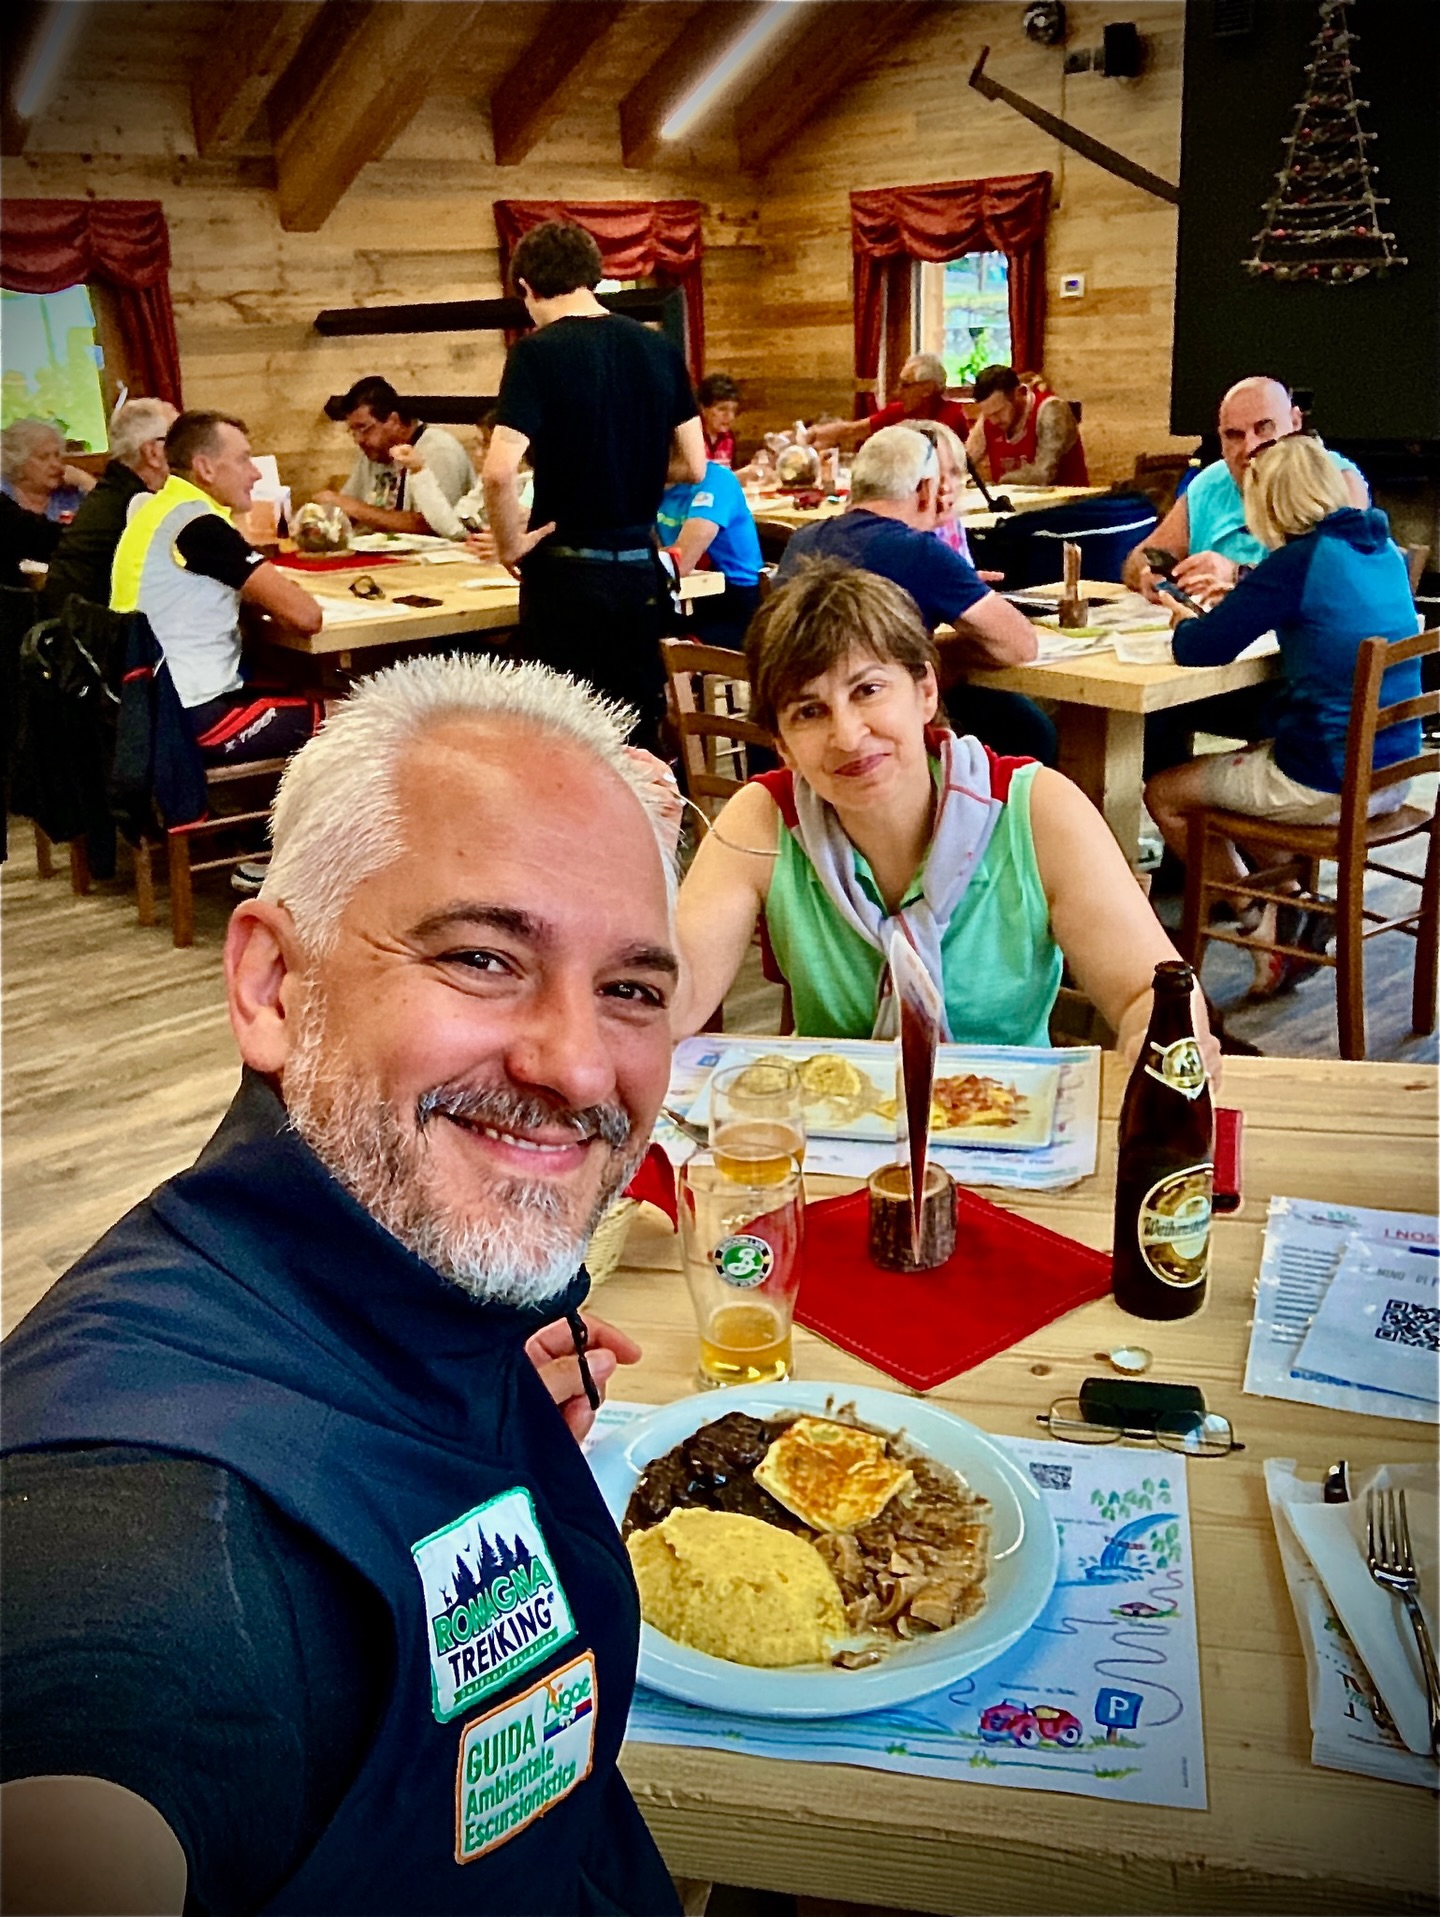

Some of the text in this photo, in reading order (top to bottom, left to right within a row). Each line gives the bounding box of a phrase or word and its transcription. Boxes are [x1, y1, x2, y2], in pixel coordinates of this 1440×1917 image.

[1395, 1229, 1440, 1245] NOS
[433, 1554, 552, 1657] ROMAGNA
[448, 1597, 552, 1689] TREKKING
[460, 1669, 504, 1698] Outdoor
[1107, 1694, 1131, 1719] P
[465, 1745, 555, 1822] Ambientale
[466, 1714, 537, 1785] GUIDA
[464, 1759, 577, 1854] Escursionistica
